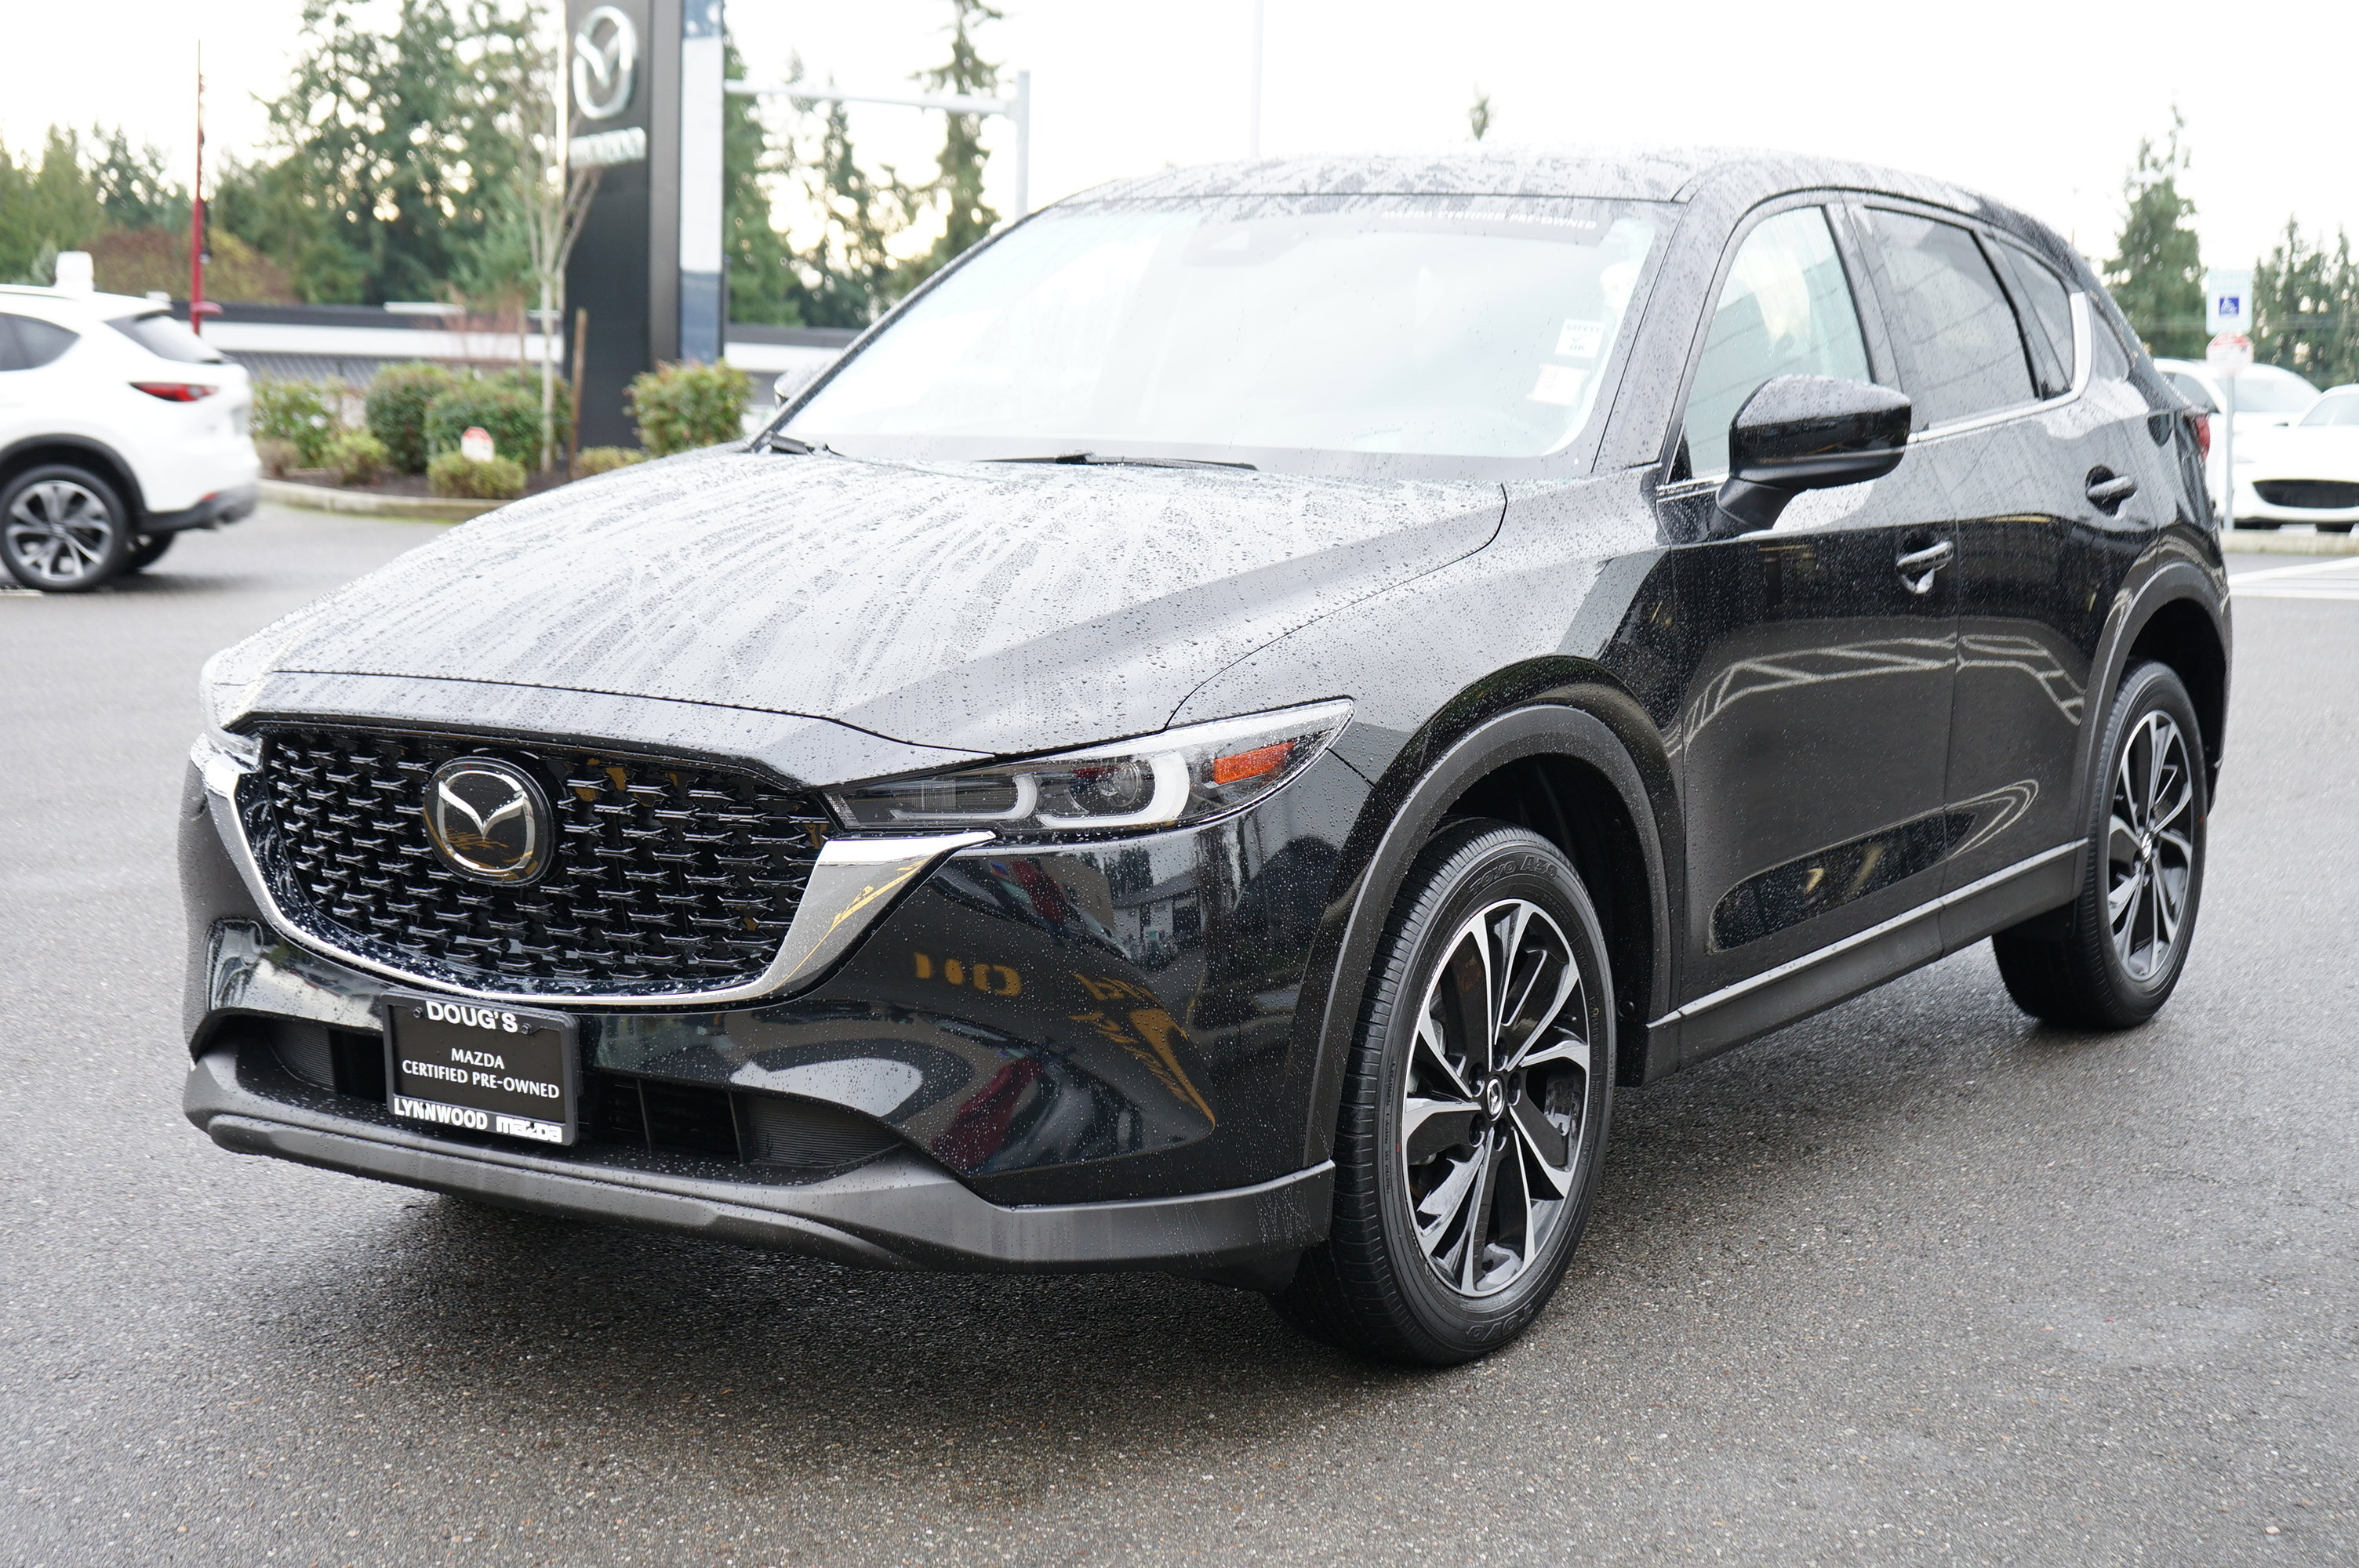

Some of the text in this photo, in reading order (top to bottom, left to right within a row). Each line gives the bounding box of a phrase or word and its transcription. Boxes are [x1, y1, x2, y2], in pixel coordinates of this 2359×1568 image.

[1566, 324, 1601, 333] SAFETY
[1569, 343, 1587, 351] OK
[426, 1001, 518, 1033] DOUG'S
[452, 1047, 505, 1069] MAZDA
[402, 1060, 560, 1098] CERTIFIED PRE-OWNED
[394, 1098, 488, 1130] LYNNWOOD
